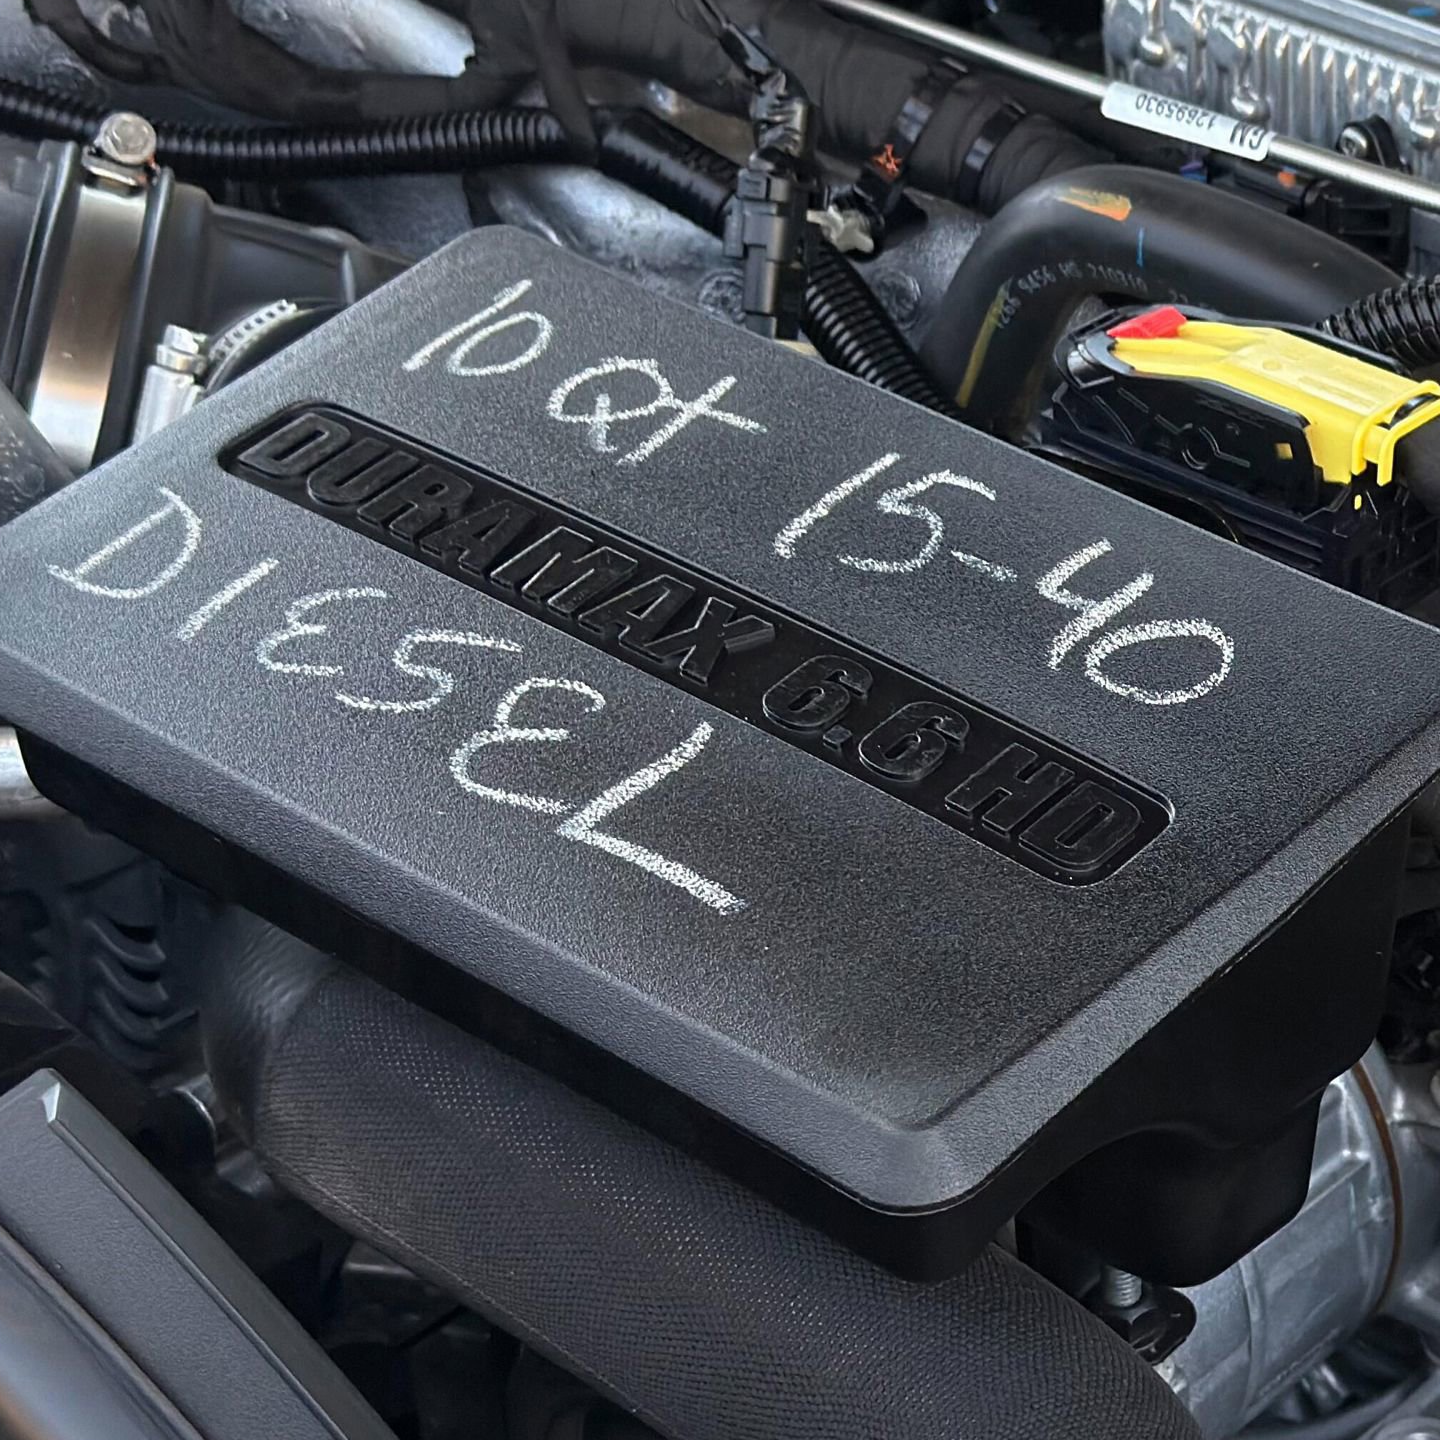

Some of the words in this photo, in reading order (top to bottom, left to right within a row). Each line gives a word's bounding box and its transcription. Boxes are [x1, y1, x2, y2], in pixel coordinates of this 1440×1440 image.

[52, 486, 744, 916] DIESEL
[235, 411, 777, 685] DURAMAX
[762, 655, 972, 784] 6.6
[945, 743, 1142, 872] HD
[404, 279, 552, 376] 10
[775, 452, 1236, 706] 15-40
